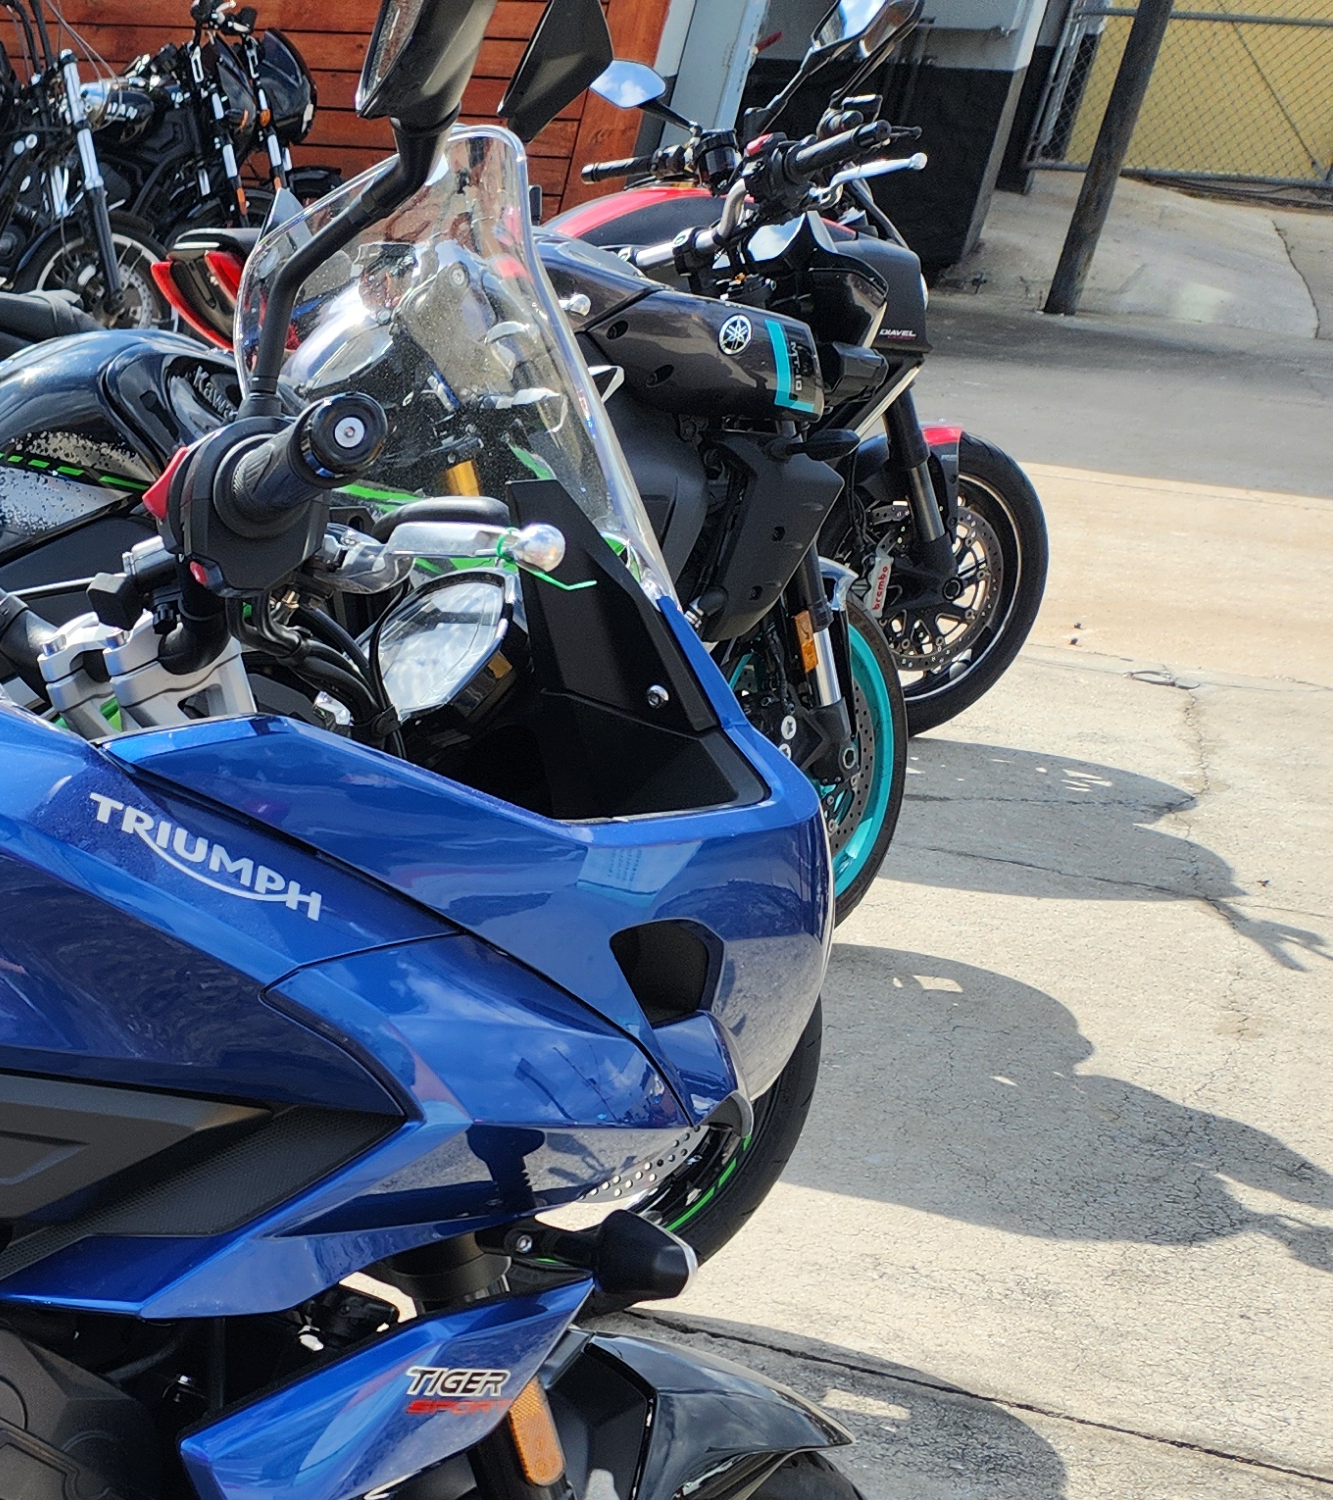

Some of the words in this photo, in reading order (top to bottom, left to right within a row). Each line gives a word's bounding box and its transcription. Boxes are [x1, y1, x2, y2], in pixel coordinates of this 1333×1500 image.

[879, 328, 917, 337] DIAVEL
[789, 341, 803, 391] MT-10
[873, 566, 889, 611] brembo
[89, 792, 322, 921] TRIUMPH
[405, 1365, 511, 1396] TIGER
[405, 1399, 514, 1415] SPORT
